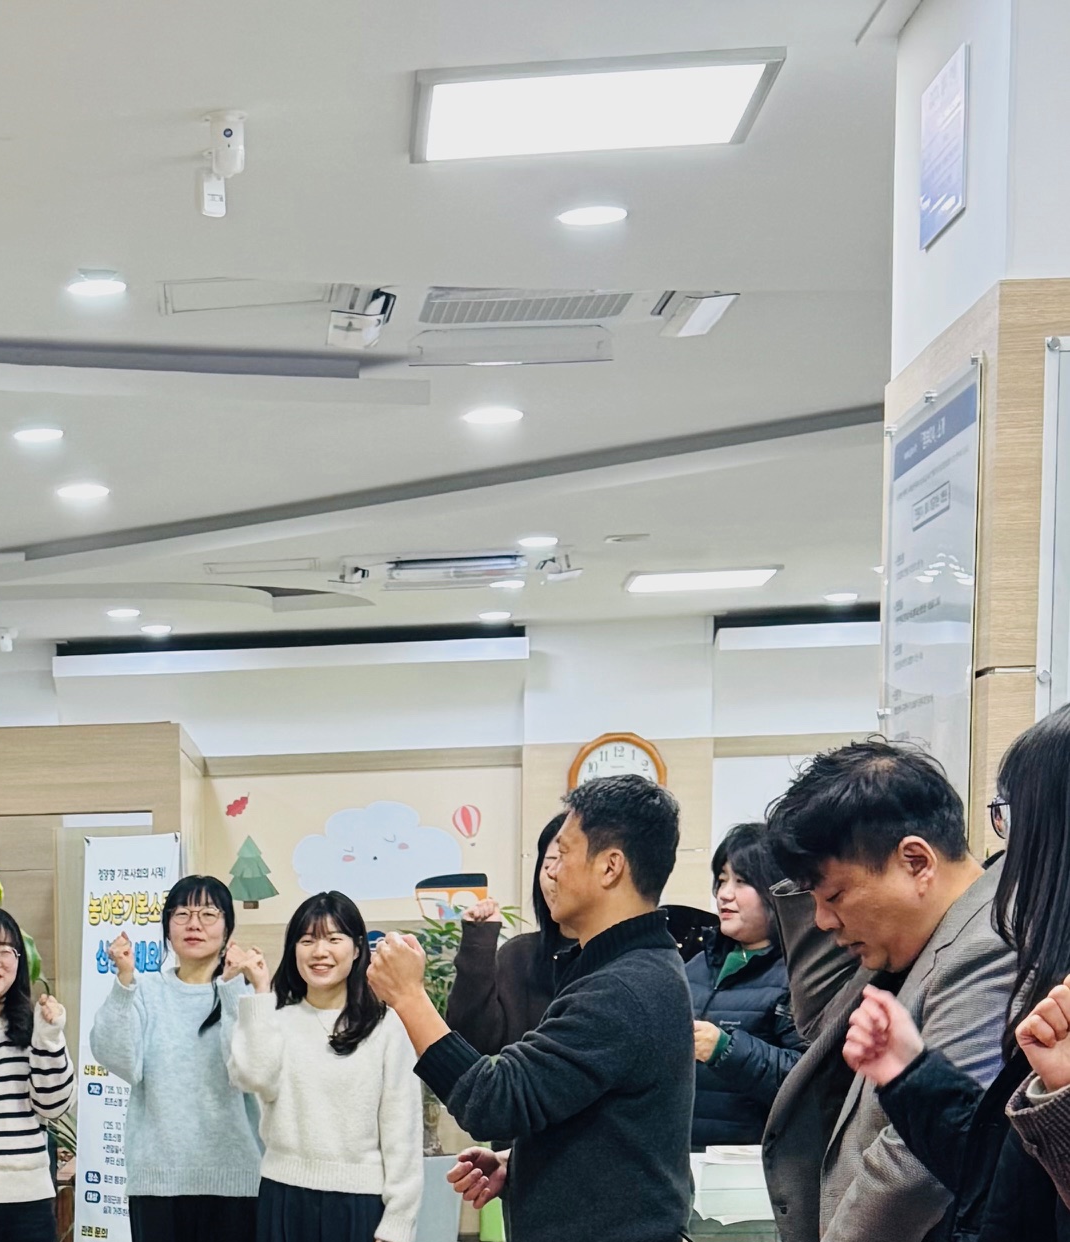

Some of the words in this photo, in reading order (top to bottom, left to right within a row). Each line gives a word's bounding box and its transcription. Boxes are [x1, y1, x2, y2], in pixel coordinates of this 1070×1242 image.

[599, 750, 609, 761] 11
[613, 746, 625, 757] 12
[587, 762, 598, 772] 10
[641, 760, 649, 770] 2
